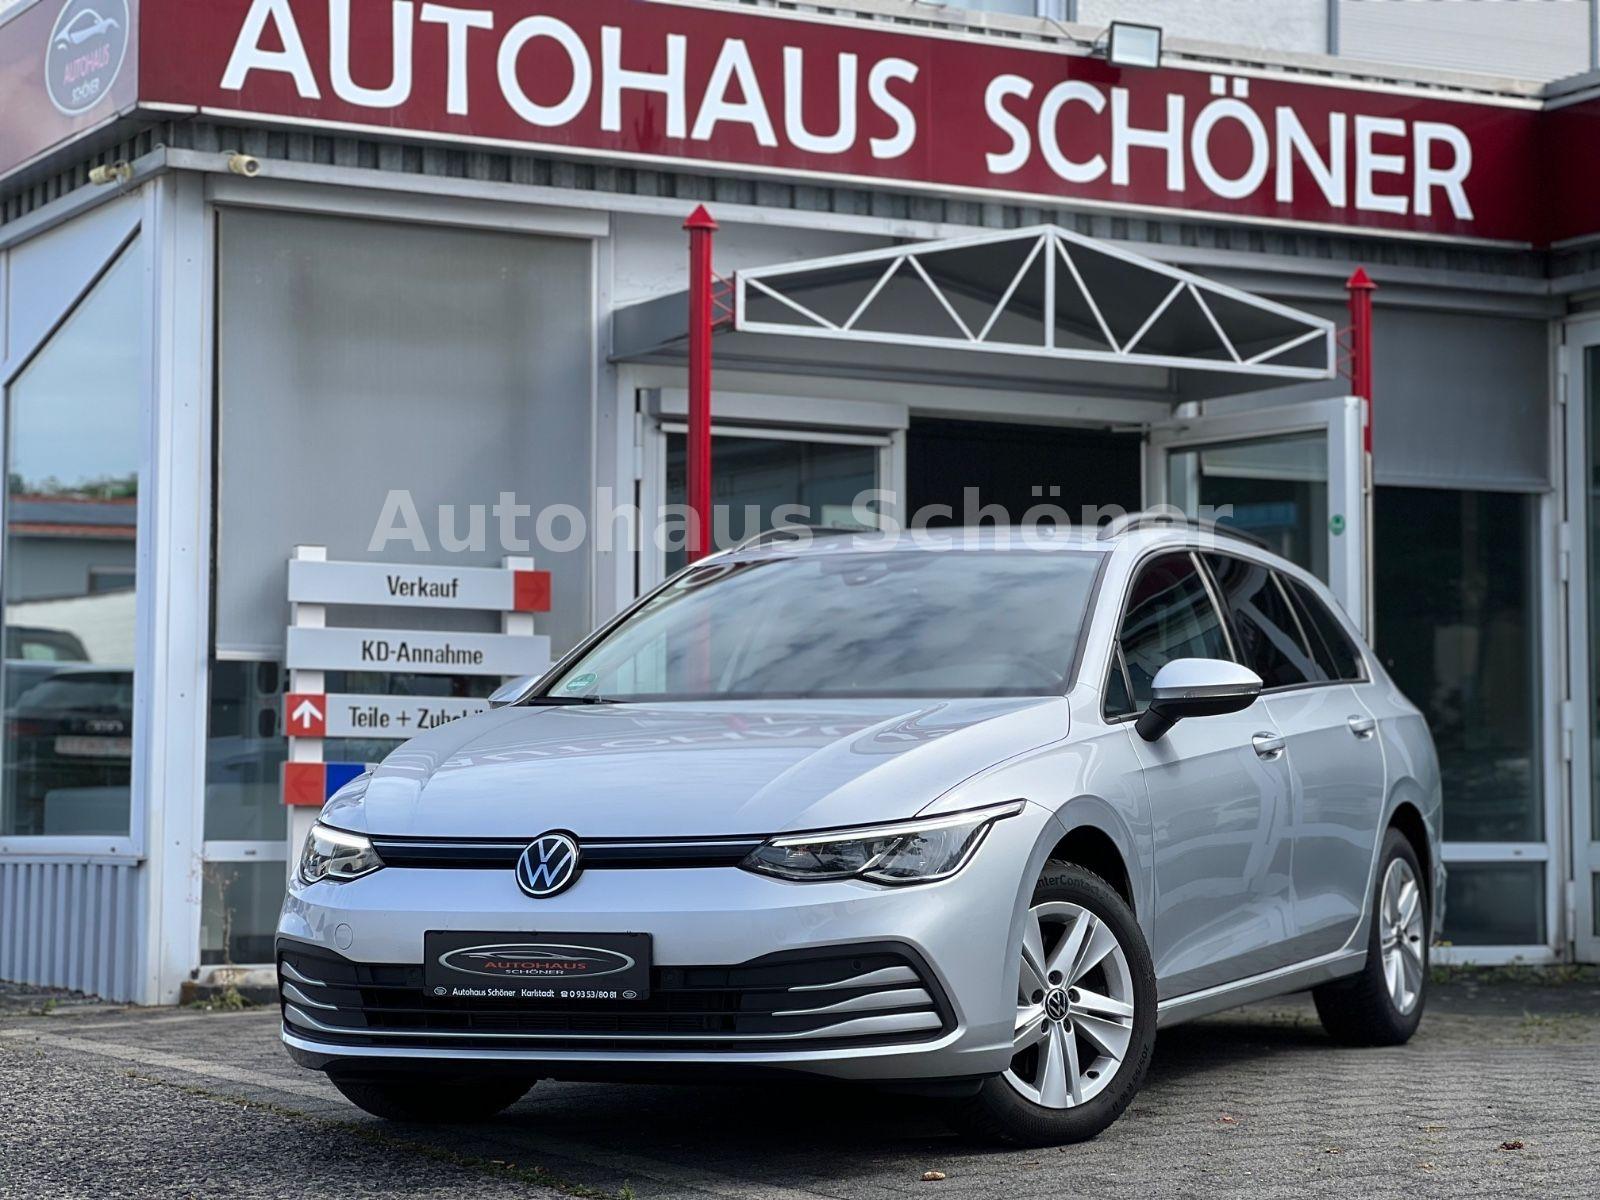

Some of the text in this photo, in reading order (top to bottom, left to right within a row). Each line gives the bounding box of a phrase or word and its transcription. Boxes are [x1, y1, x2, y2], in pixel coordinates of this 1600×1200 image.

[220, 0, 1474, 221] AUTOHAUS SCHÖNER
[386, 575, 460, 598] Verkauf
[361, 639, 484, 665] KD-Annahme
[348, 705, 390, 728] Teile
[396, 710, 411, 727] +
[484, 961, 588, 970] AUTOHAUS
[452, 987, 487, 997] Autohaus
[487, 988, 516, 997] Schöner
[521, 988, 555, 998] Karlstadt
